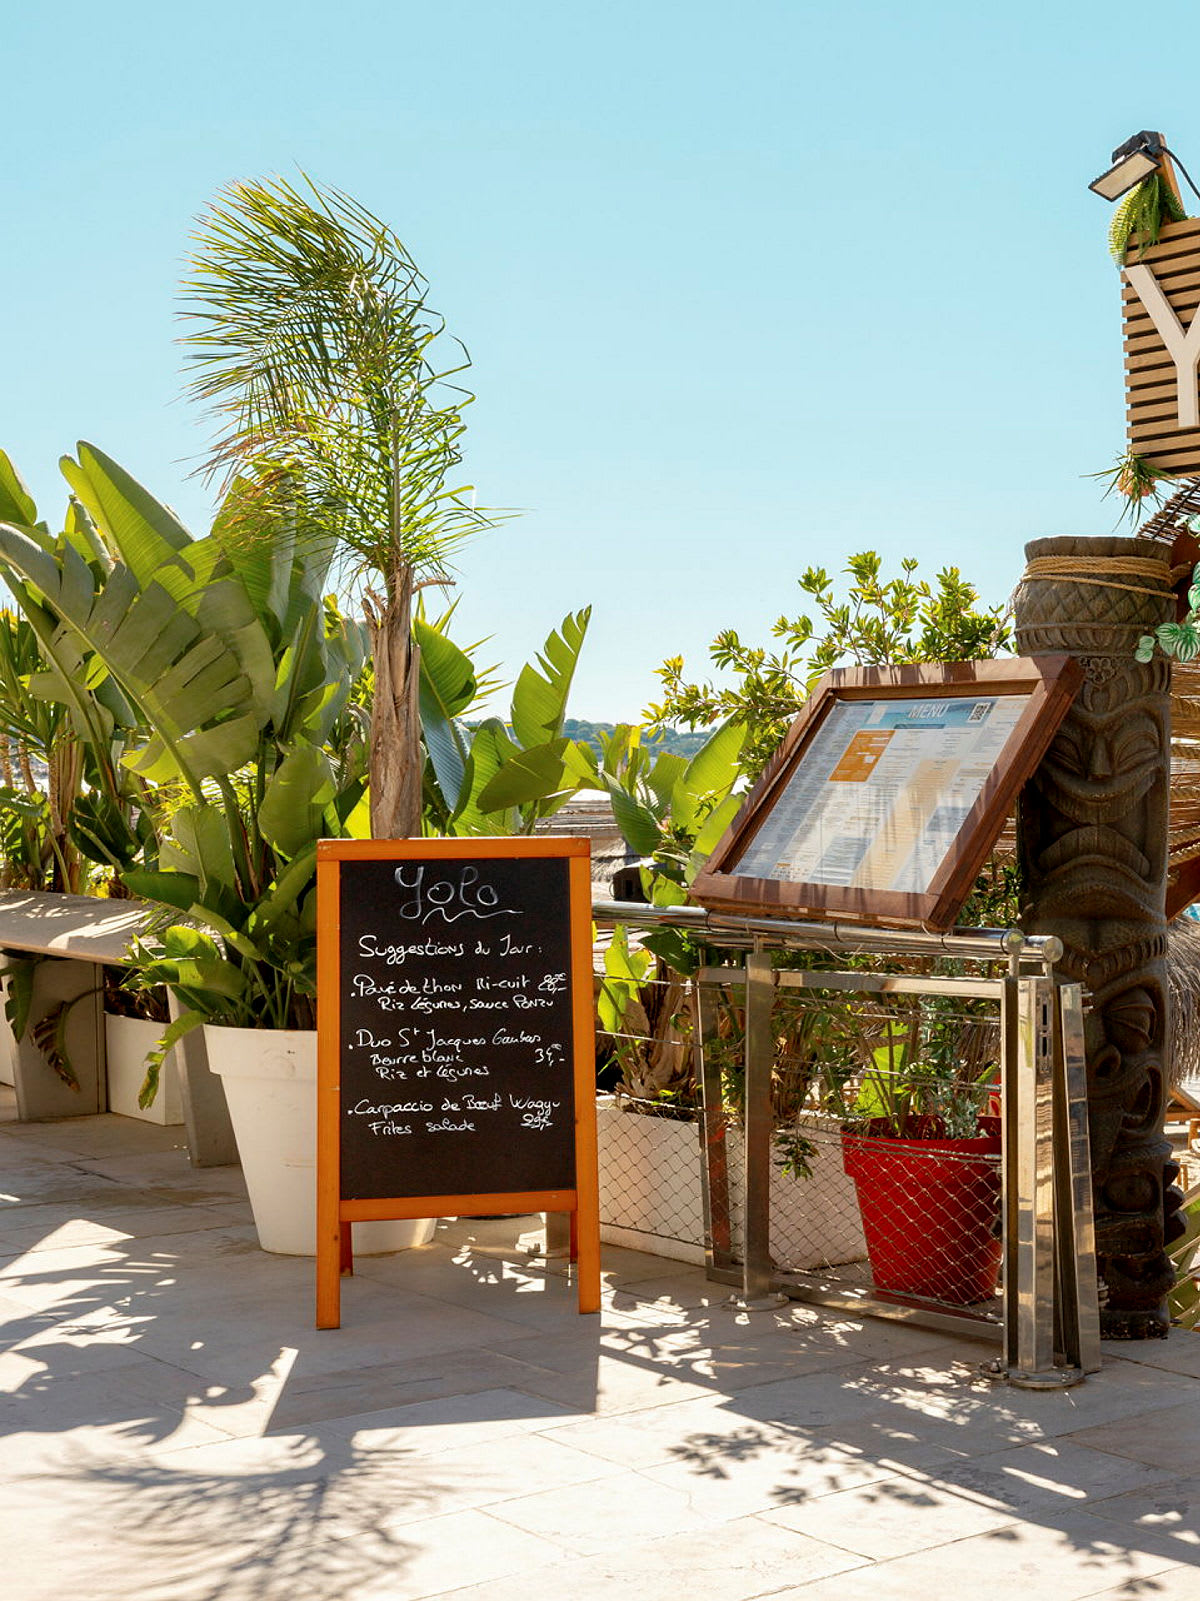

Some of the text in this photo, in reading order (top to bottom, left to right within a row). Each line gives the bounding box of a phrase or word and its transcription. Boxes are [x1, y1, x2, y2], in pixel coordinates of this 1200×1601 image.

[907, 703, 950, 719] MENU
[359, 935, 464, 965] Suggestions
[475, 941, 490, 955] du
[398, 979, 421, 994] de
[377, 996, 406, 1012] Riz
[469, 998, 509, 1010] sauce
[356, 1028, 392, 1047] Duo
[426, 1029, 487, 1052] Jacques
[370, 1053, 419, 1066] Beurre
[422, 1050, 464, 1063] blanc
[375, 1066, 408, 1081] Riz
[416, 1065, 430, 1078] et
[354, 1098, 434, 1119] Carpaccio
[441, 1097, 461, 1112] de
[509, 1093, 560, 1117] Wagyu
[368, 1120, 413, 1136] Frites
[425, 1117, 476, 1133] salade
